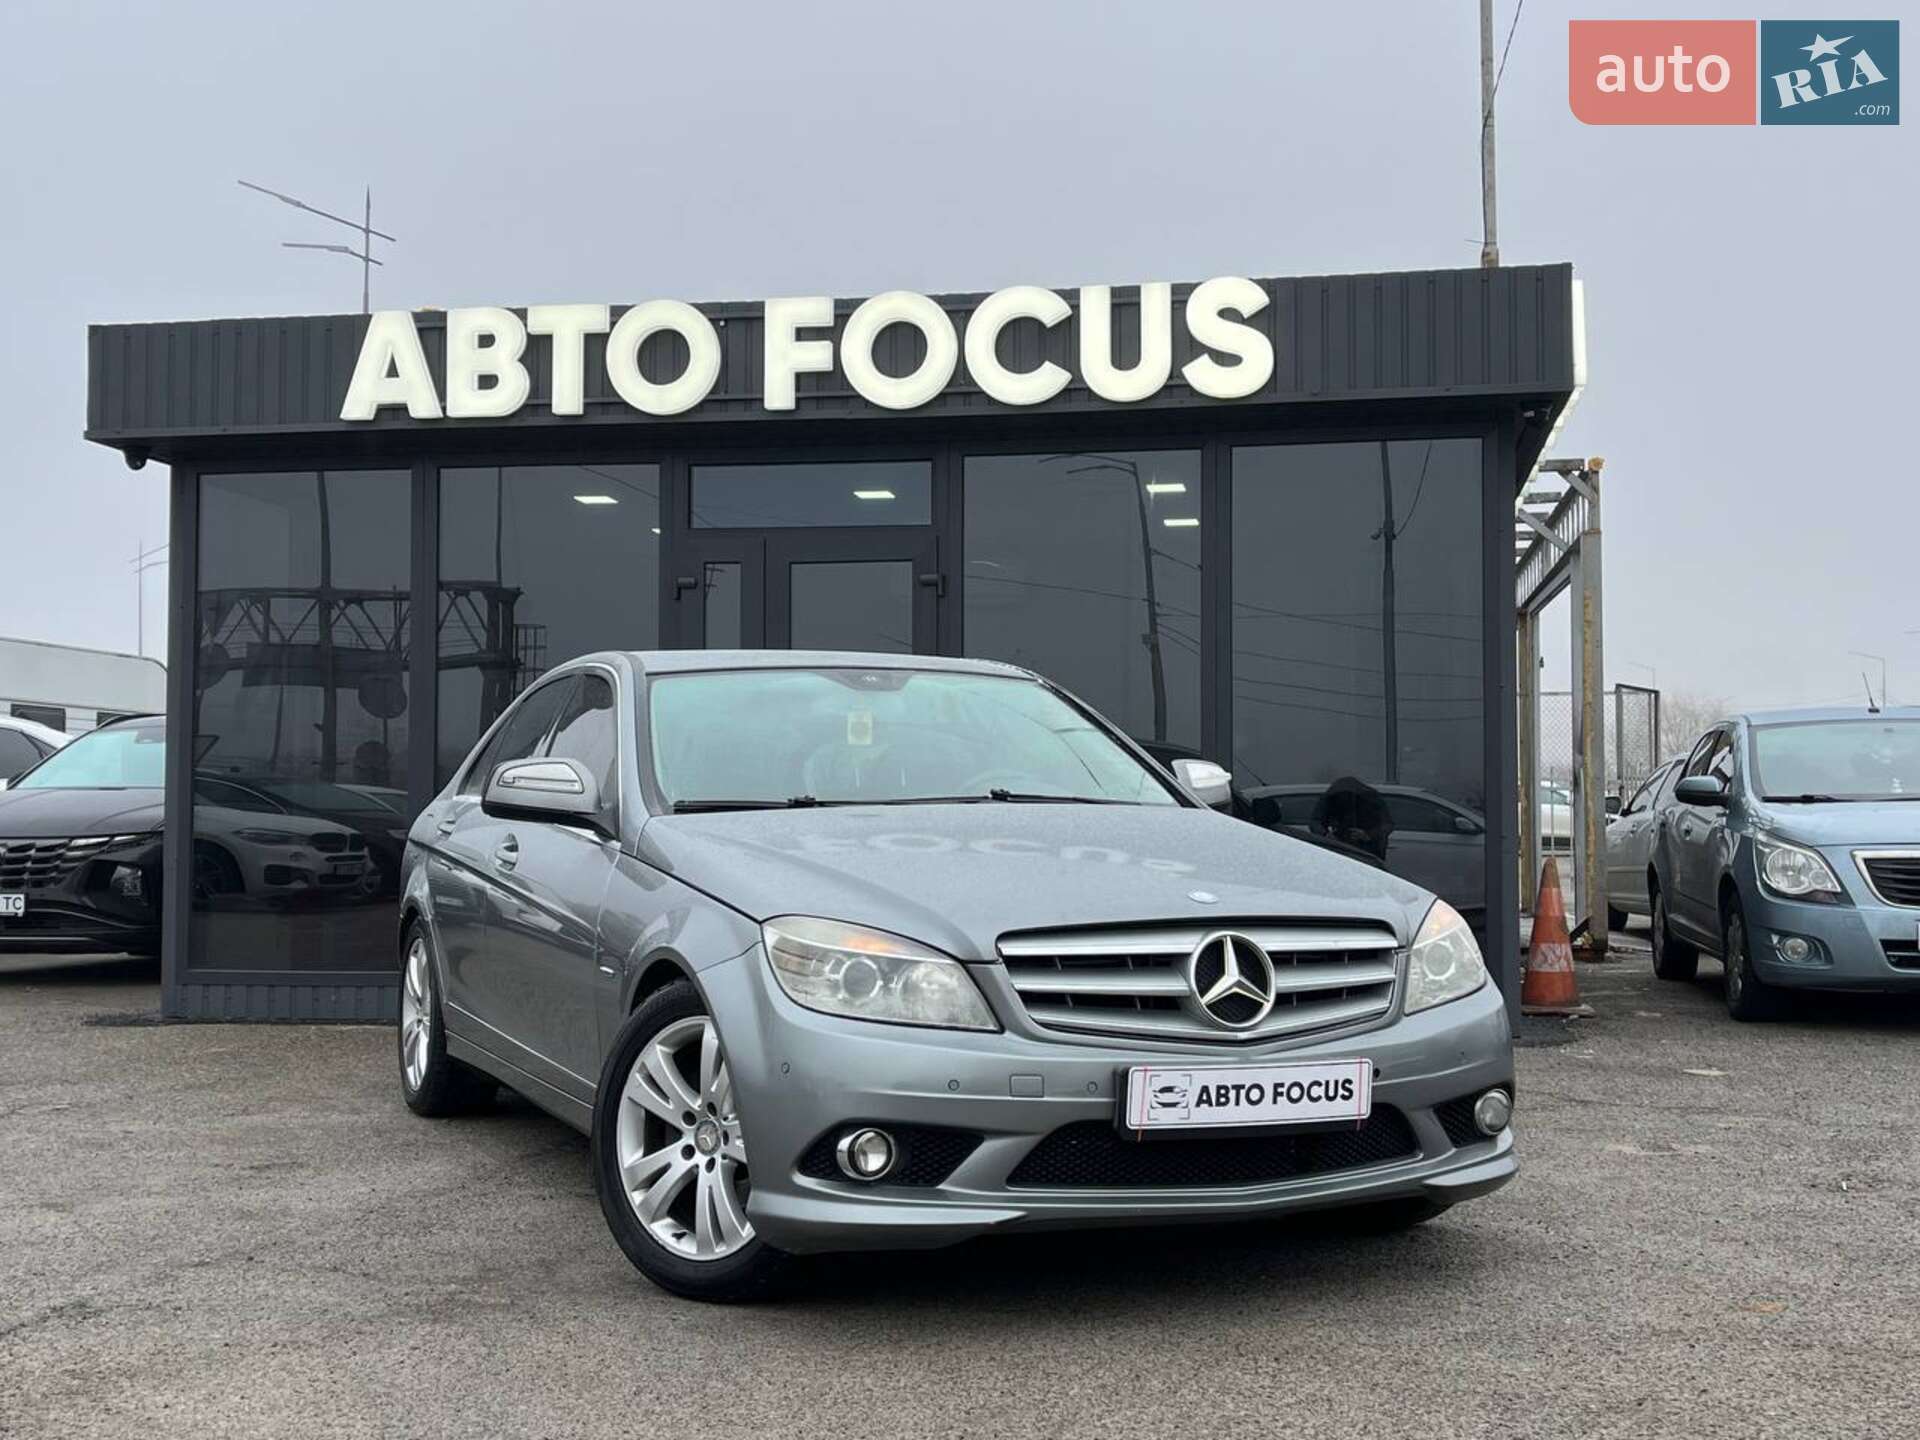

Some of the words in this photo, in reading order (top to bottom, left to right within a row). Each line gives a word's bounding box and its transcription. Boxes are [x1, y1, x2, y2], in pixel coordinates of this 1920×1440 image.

[339, 300, 721, 420] АВТО
[763, 276, 1275, 411] FOCUS
[1195, 1082, 1266, 1109] АВТО
[1272, 1078, 1355, 1105] FOCUS
